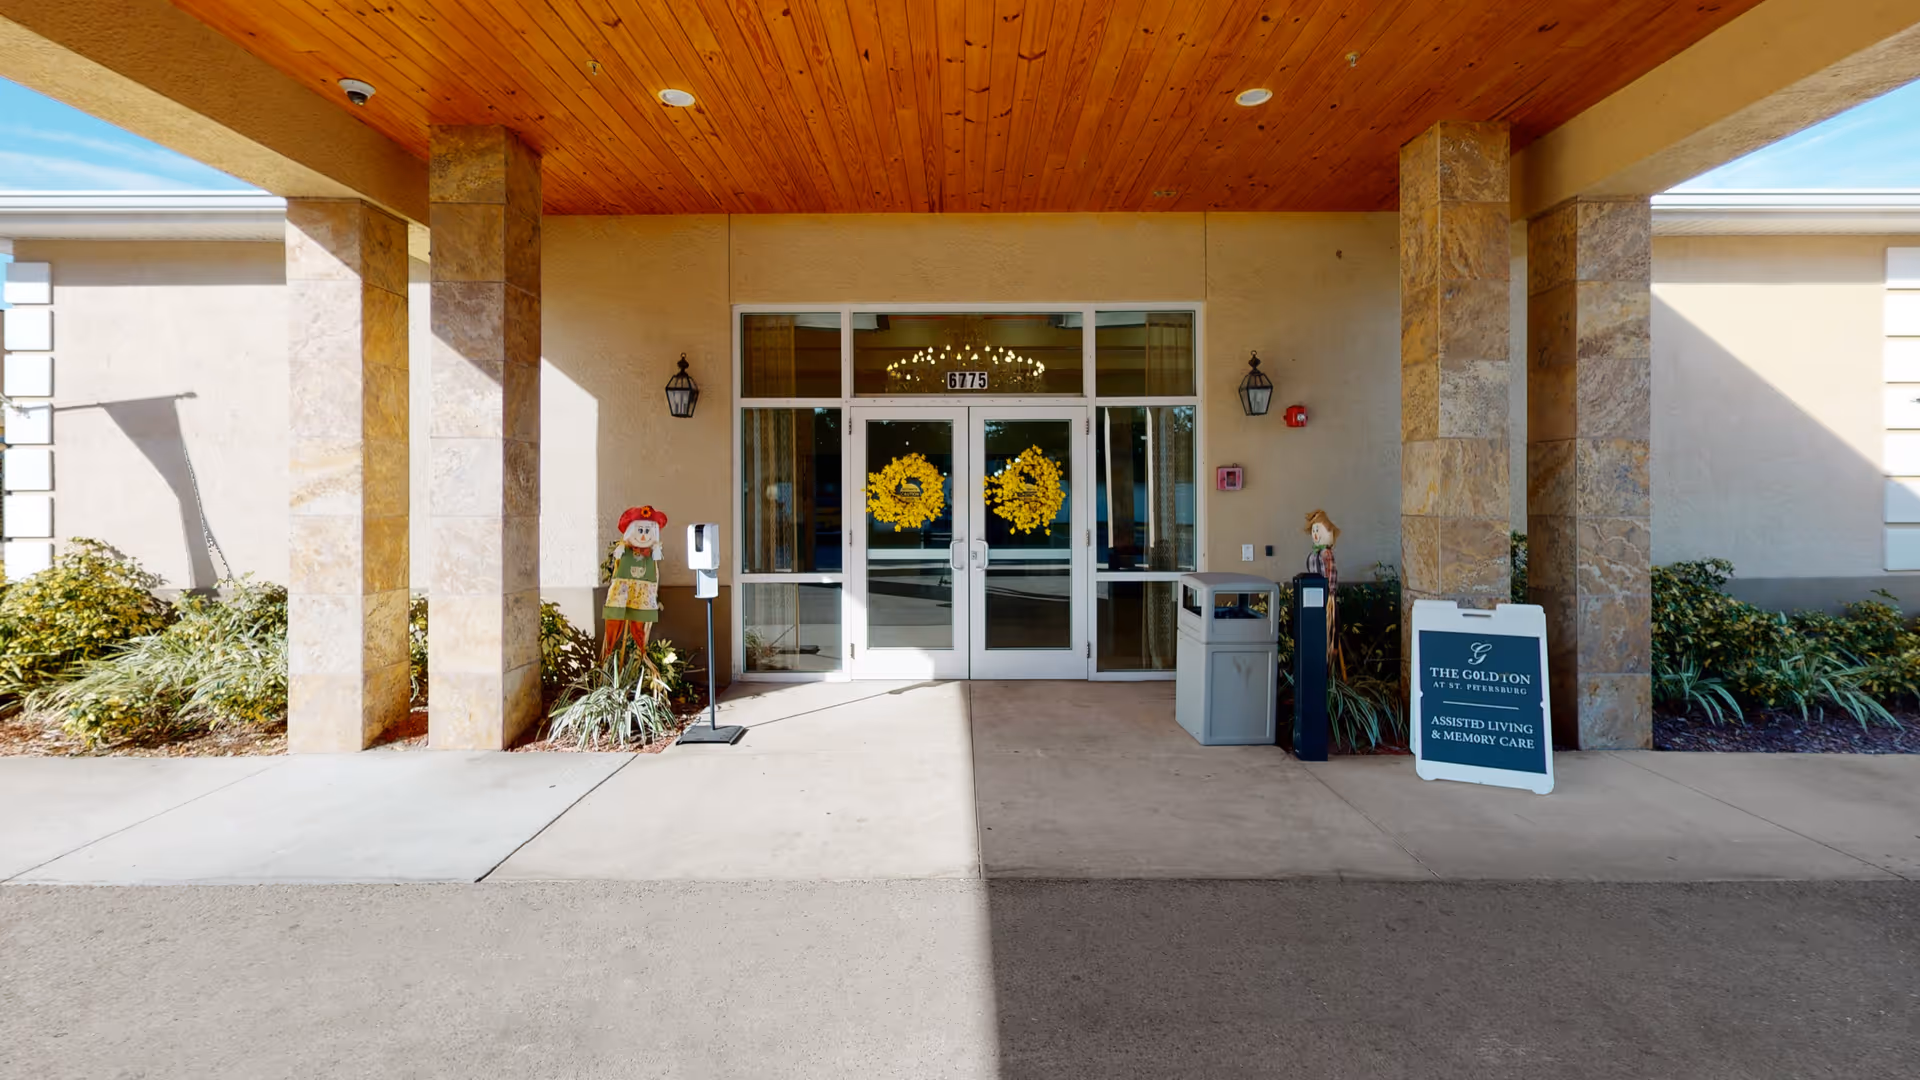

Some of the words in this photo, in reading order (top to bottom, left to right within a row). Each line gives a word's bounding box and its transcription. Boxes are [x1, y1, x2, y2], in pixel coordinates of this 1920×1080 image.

[949, 372, 986, 388] 6775
[1430, 667, 1459, 679] THE
[1462, 669, 1531, 685] GOLDTON
[1467, 684, 1527, 695] PETERSBURG
[1431, 716, 1485, 729] ASSISTED
[1488, 721, 1533, 734] LIVING
[1431, 729, 1441, 739] &
[1443, 731, 1496, 745] MEMORY
[1499, 736, 1535, 749] CARE
